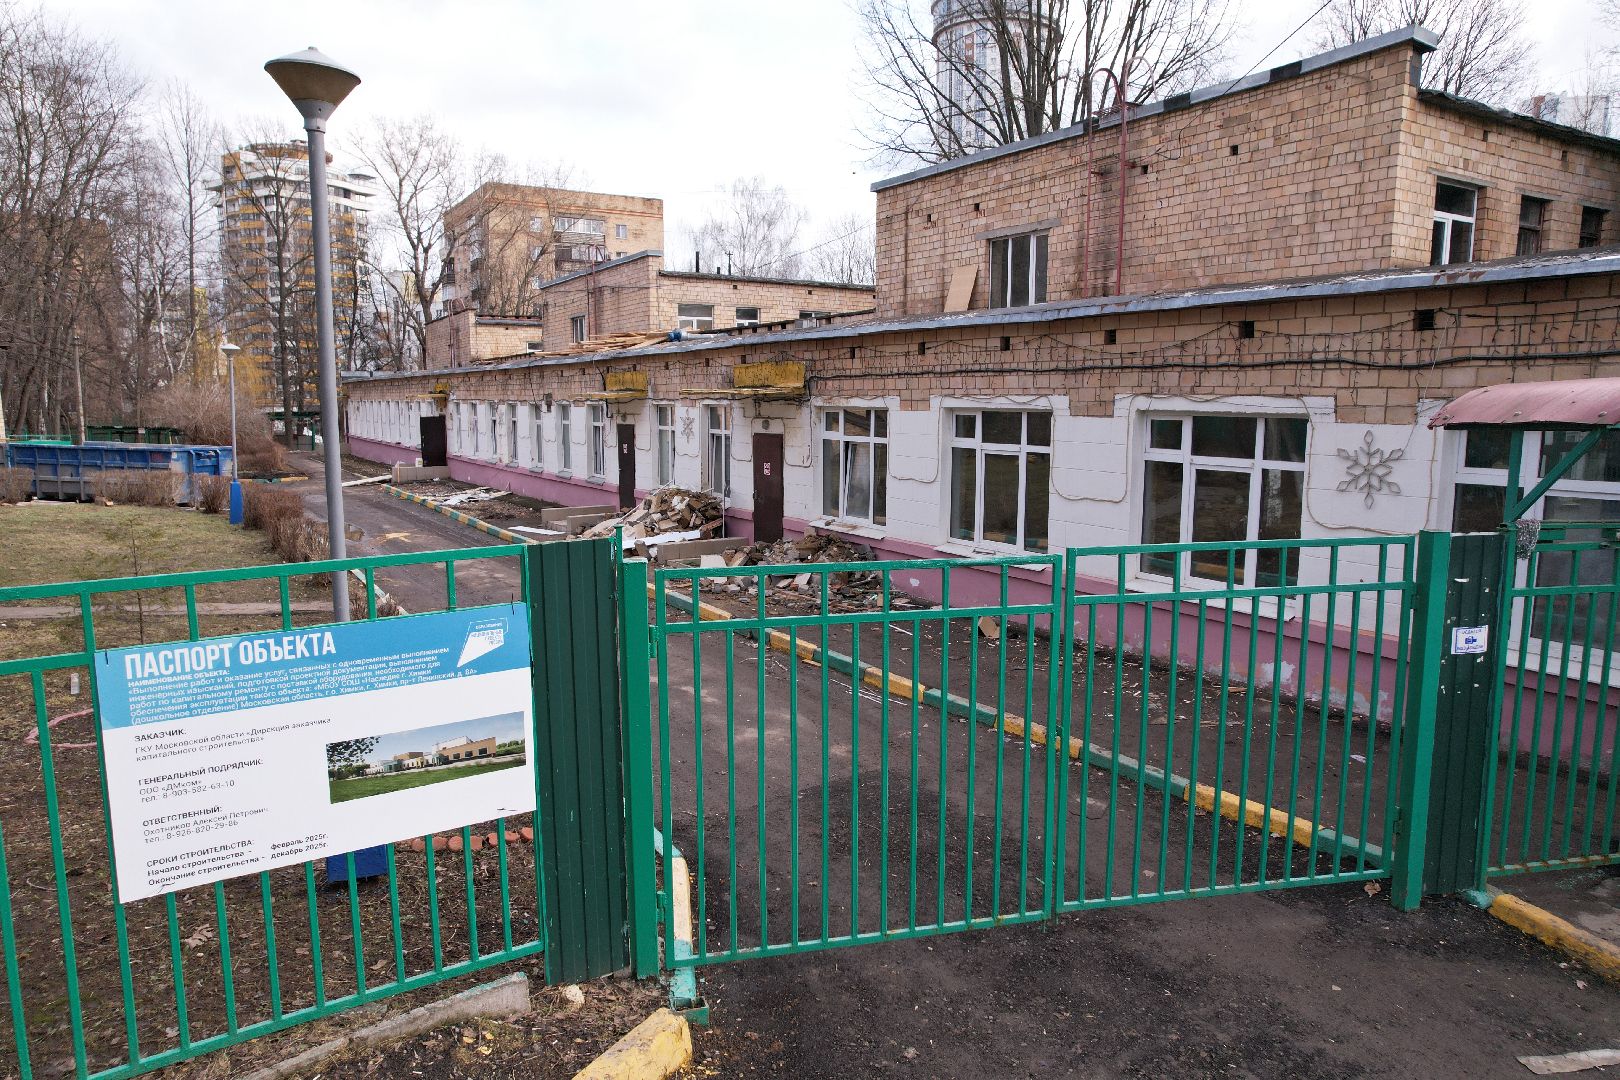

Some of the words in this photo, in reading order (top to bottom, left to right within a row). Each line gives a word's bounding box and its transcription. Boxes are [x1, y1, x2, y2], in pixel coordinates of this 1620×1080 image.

[125, 642, 232, 680] ПАСПОРТ
[239, 632, 336, 665] ОБЪЕКТА
[128, 681, 188, 695] «Выполнение
[191, 678, 215, 689] работ
[225, 673, 263, 682] оказание
[264, 670, 287, 680] услуг,
[289, 663, 331, 674] связанных
[339, 654, 400, 668] одновременным
[402, 647, 450, 659] выполнением
[128, 674, 193, 688] НАИМЕНОВАНИЕ
[194, 669, 230, 680] ОБЪЕКТА:
[129, 689, 185, 703] инженерных
[237, 675, 289, 688] подготовкой
[291, 668, 331, 681] проектной
[389, 655, 438, 667] выполнением
[130, 700, 156, 712] работ
[172, 690, 233, 704] капитальному
[235, 685, 268, 697] ремонту
[277, 678, 318, 689] поставкой
[376, 664, 426, 676] необходимого
[428, 661, 441, 669] для
[130, 704, 188, 718] обеспечения
[190, 694, 247, 709] эксплуатации
[250, 691, 277, 700] такого
[278, 686, 311, 696] объекта:
[314, 680, 339, 691] «МБОУ
[341, 679, 360, 687] СОШ
[409, 668, 432, 678] Химки
[131, 711, 190, 726] (дошкольное
[192, 701, 239, 716] отделение)
[241, 696, 290, 708] Московская
[292, 692, 323, 702] область,
[340, 686, 366, 695] Химки,
[374, 681, 399, 689] Химки,
[400, 678, 416, 686] пр-т
[134, 728, 187, 743] ЗАКАЗЧИК:
[135, 745, 153, 754] ГКУ
[156, 735, 209, 752] Московской
[211, 731, 244, 743] области
[246, 724, 290, 737] «Дирекция
[292, 718, 331, 730] заказчика
[136, 747, 197, 763] капитального
[199, 736, 265, 752] строительства»
[138, 767, 206, 786] ГЕНЕРАЛЬНЫЙ
[208, 757, 264, 775] ПОДРЯДЧИК:
[139, 786, 159, 796] ООО
[161, 779, 203, 792] «ДМком»
[141, 794, 160, 804] тел.:
[142, 805, 223, 828] ОТВЕТСТВЕННЫЙ:
[143, 822, 191, 838] Охотников
[193, 815, 228, 827] Алексей
[229, 807, 269, 819] Петрович
[146, 855, 178, 869] СРОКИ
[180, 839, 255, 860] СТРОИТЕЛЬСТВА:
[147, 865, 180, 877] Начало
[182, 851, 245, 870] строительства
[270, 839, 304, 851] февраль
[305, 833, 328, 843] 2025г.
[149, 871, 196, 886] Окончание
[198, 856, 259, 877] строительства
[270, 847, 303, 860] декабрь
[305, 842, 328, 853] 2025г.
